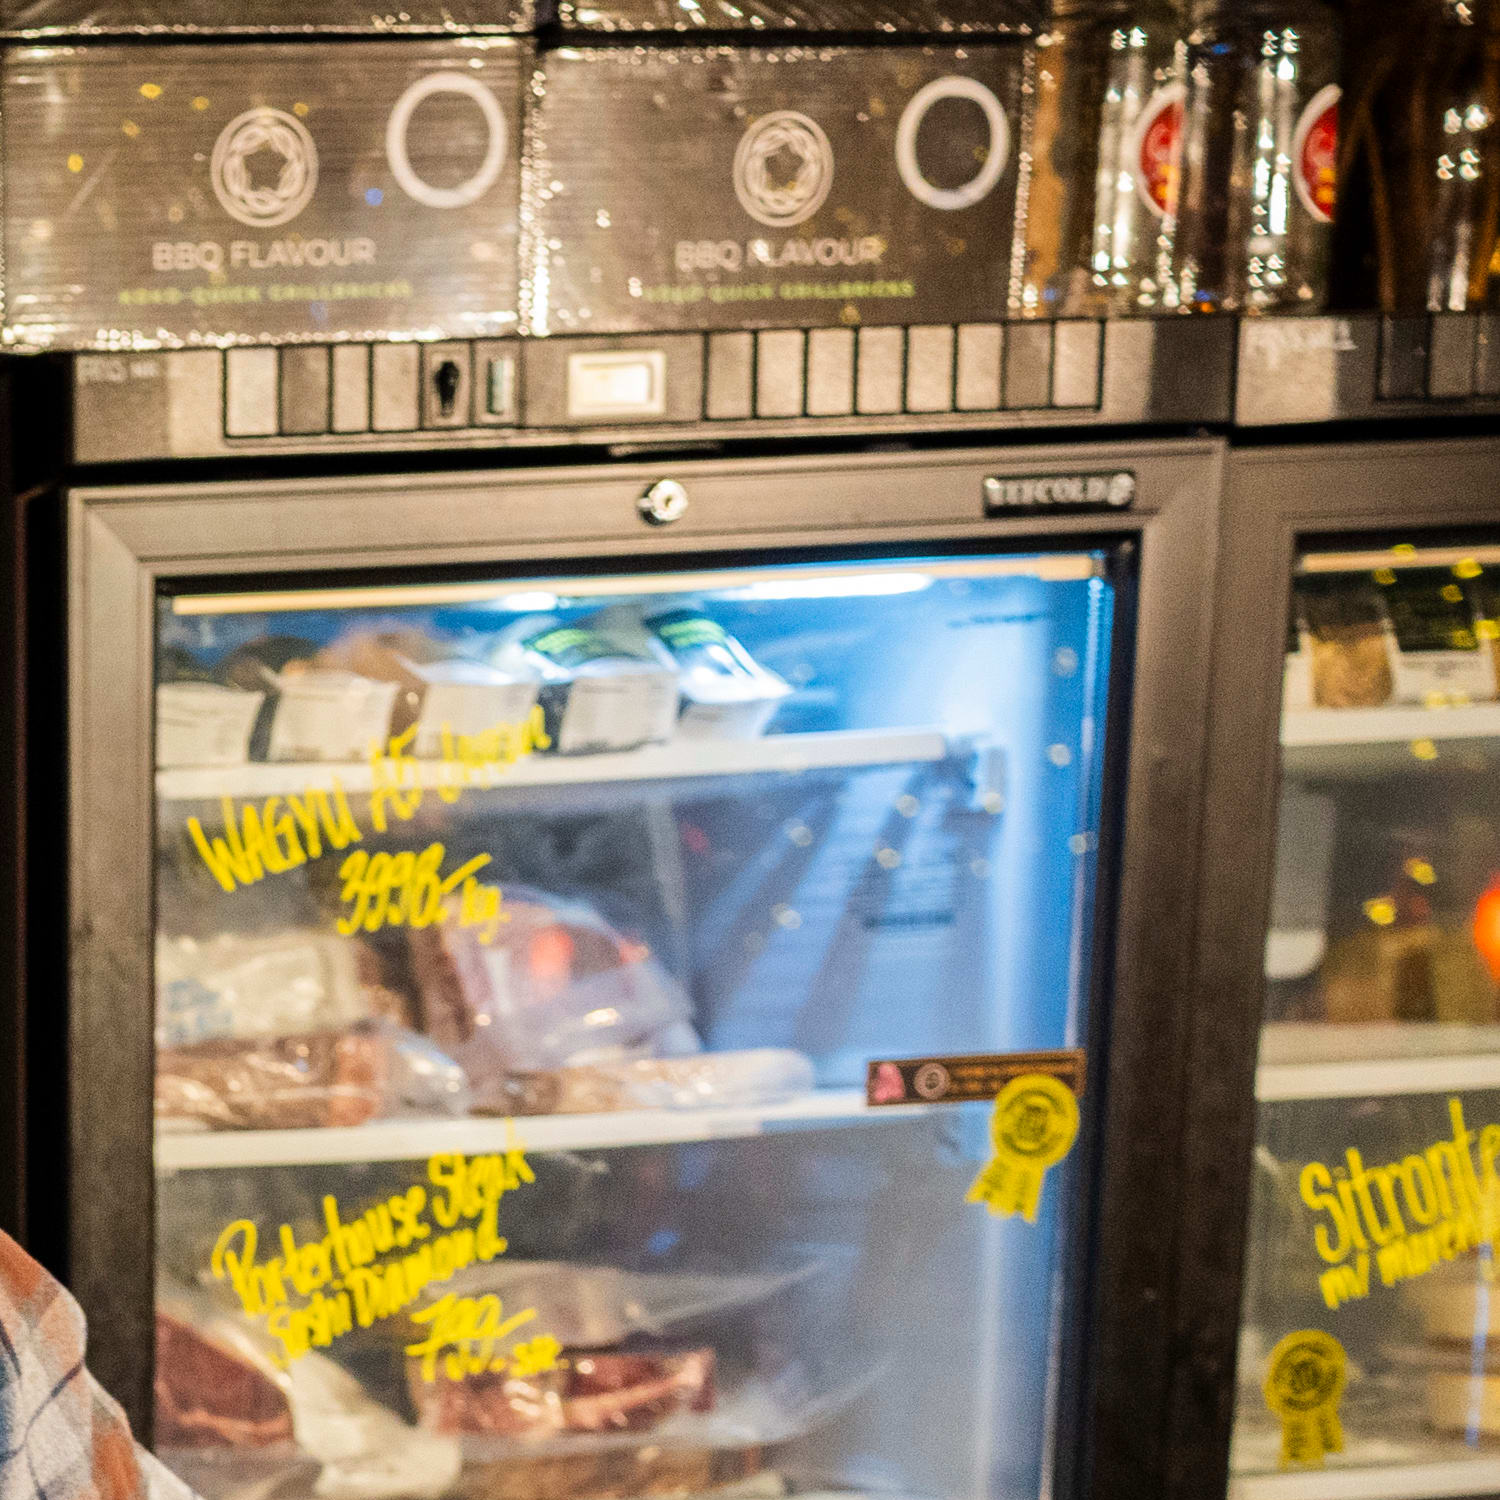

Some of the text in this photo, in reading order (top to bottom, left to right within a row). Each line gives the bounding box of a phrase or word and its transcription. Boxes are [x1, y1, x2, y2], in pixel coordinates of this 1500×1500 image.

[152, 236, 378, 272] BBQ FLAVOUR
[675, 240, 743, 273] BBQ
